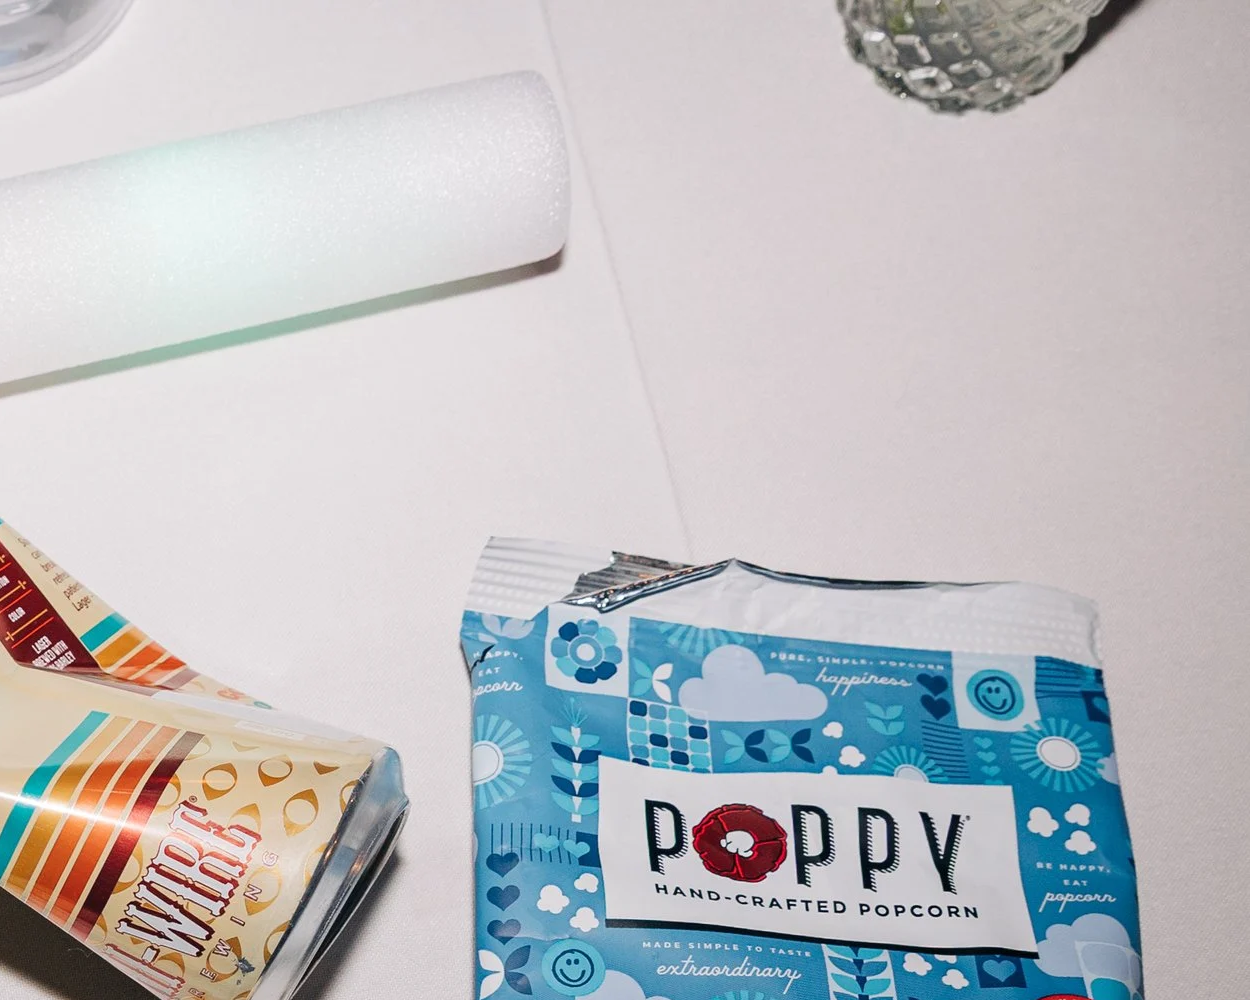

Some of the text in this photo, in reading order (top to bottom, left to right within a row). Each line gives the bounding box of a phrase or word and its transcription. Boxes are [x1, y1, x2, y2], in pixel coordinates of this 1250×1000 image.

[8, 607, 26, 622] COLOR
[32, 636, 52, 653] LAGER
[53, 640, 69, 657] WITH
[879, 660, 944, 670] POPCORN
[815, 667, 912, 696] happiness
[655, 882, 978, 918] HAND-CRAFTED POPCORN
[1039, 892, 1117, 913] popcorn
[770, 948, 810, 957] TASTE
[657, 953, 801, 994] extraordinary
